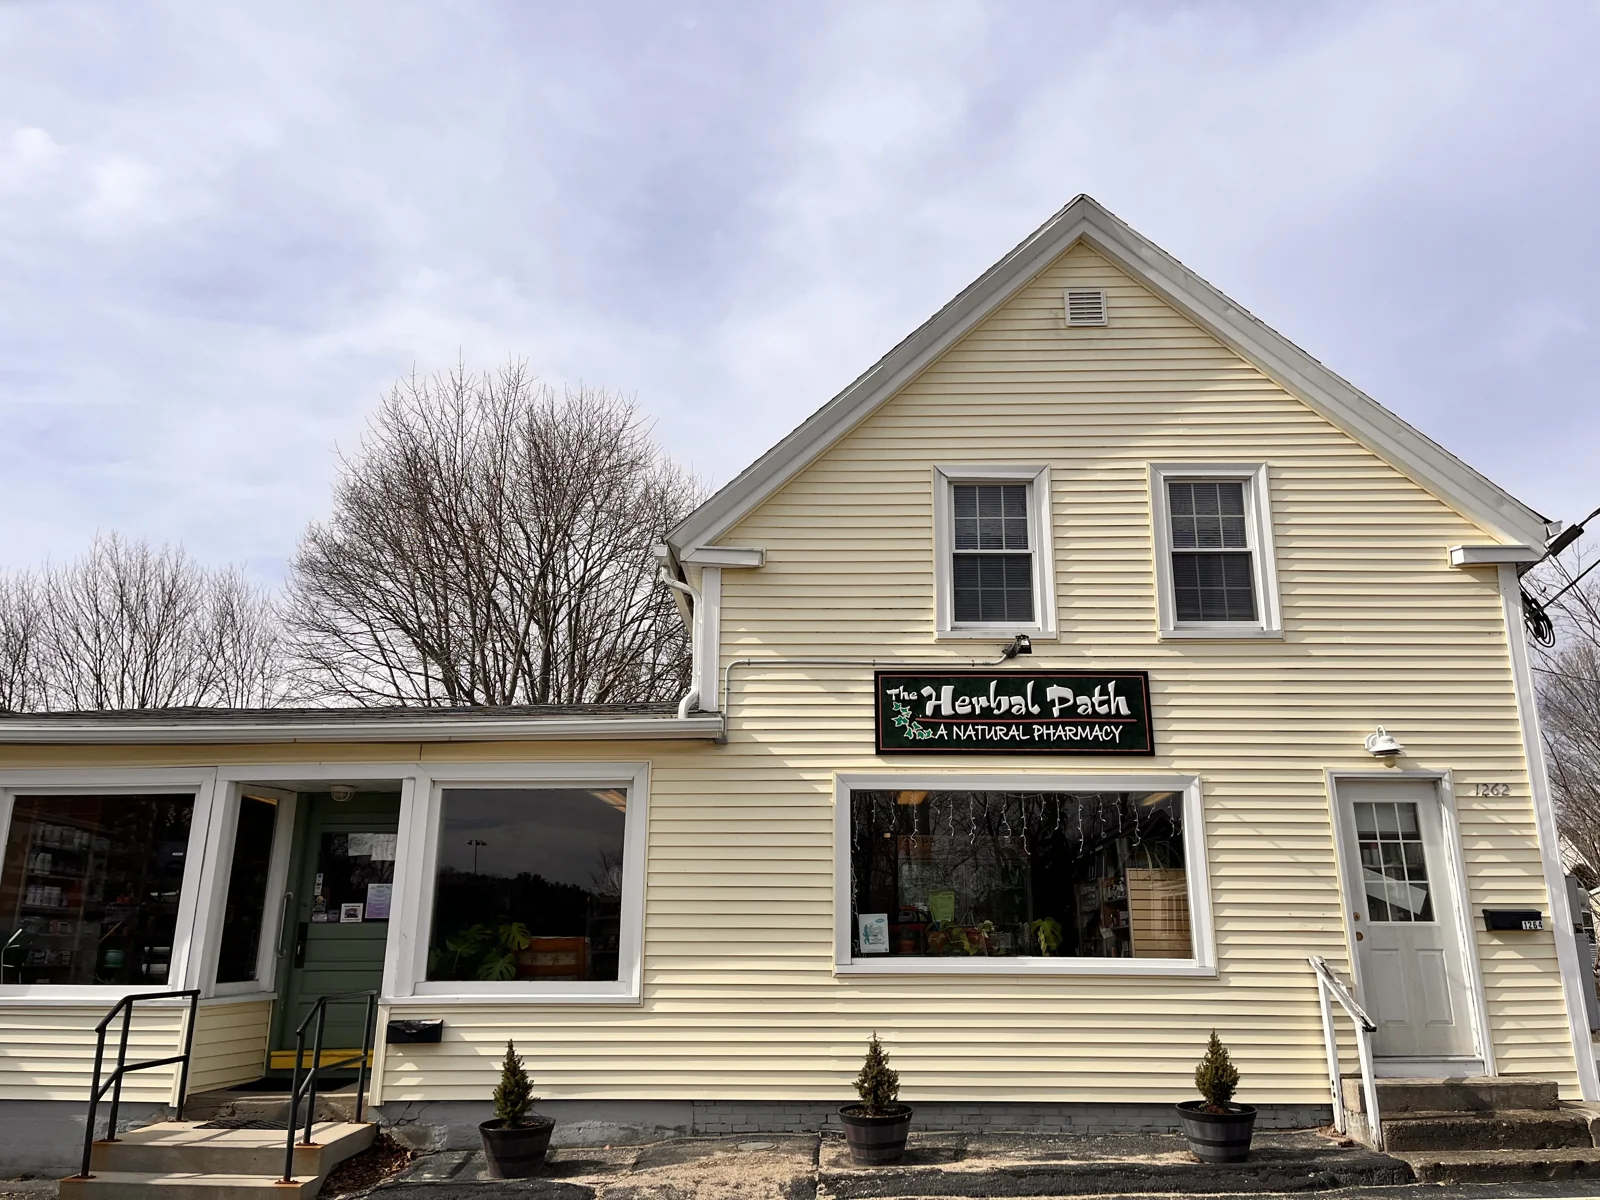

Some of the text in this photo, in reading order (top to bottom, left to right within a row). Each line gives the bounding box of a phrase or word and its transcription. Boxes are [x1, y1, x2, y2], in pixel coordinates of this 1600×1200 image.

[886, 680, 1131, 718] The Herbal Path
[934, 725, 1123, 743] A NATURAL PHARMACY
[1475, 783, 1511, 797] 1262
[1523, 920, 1543, 930] 1264
